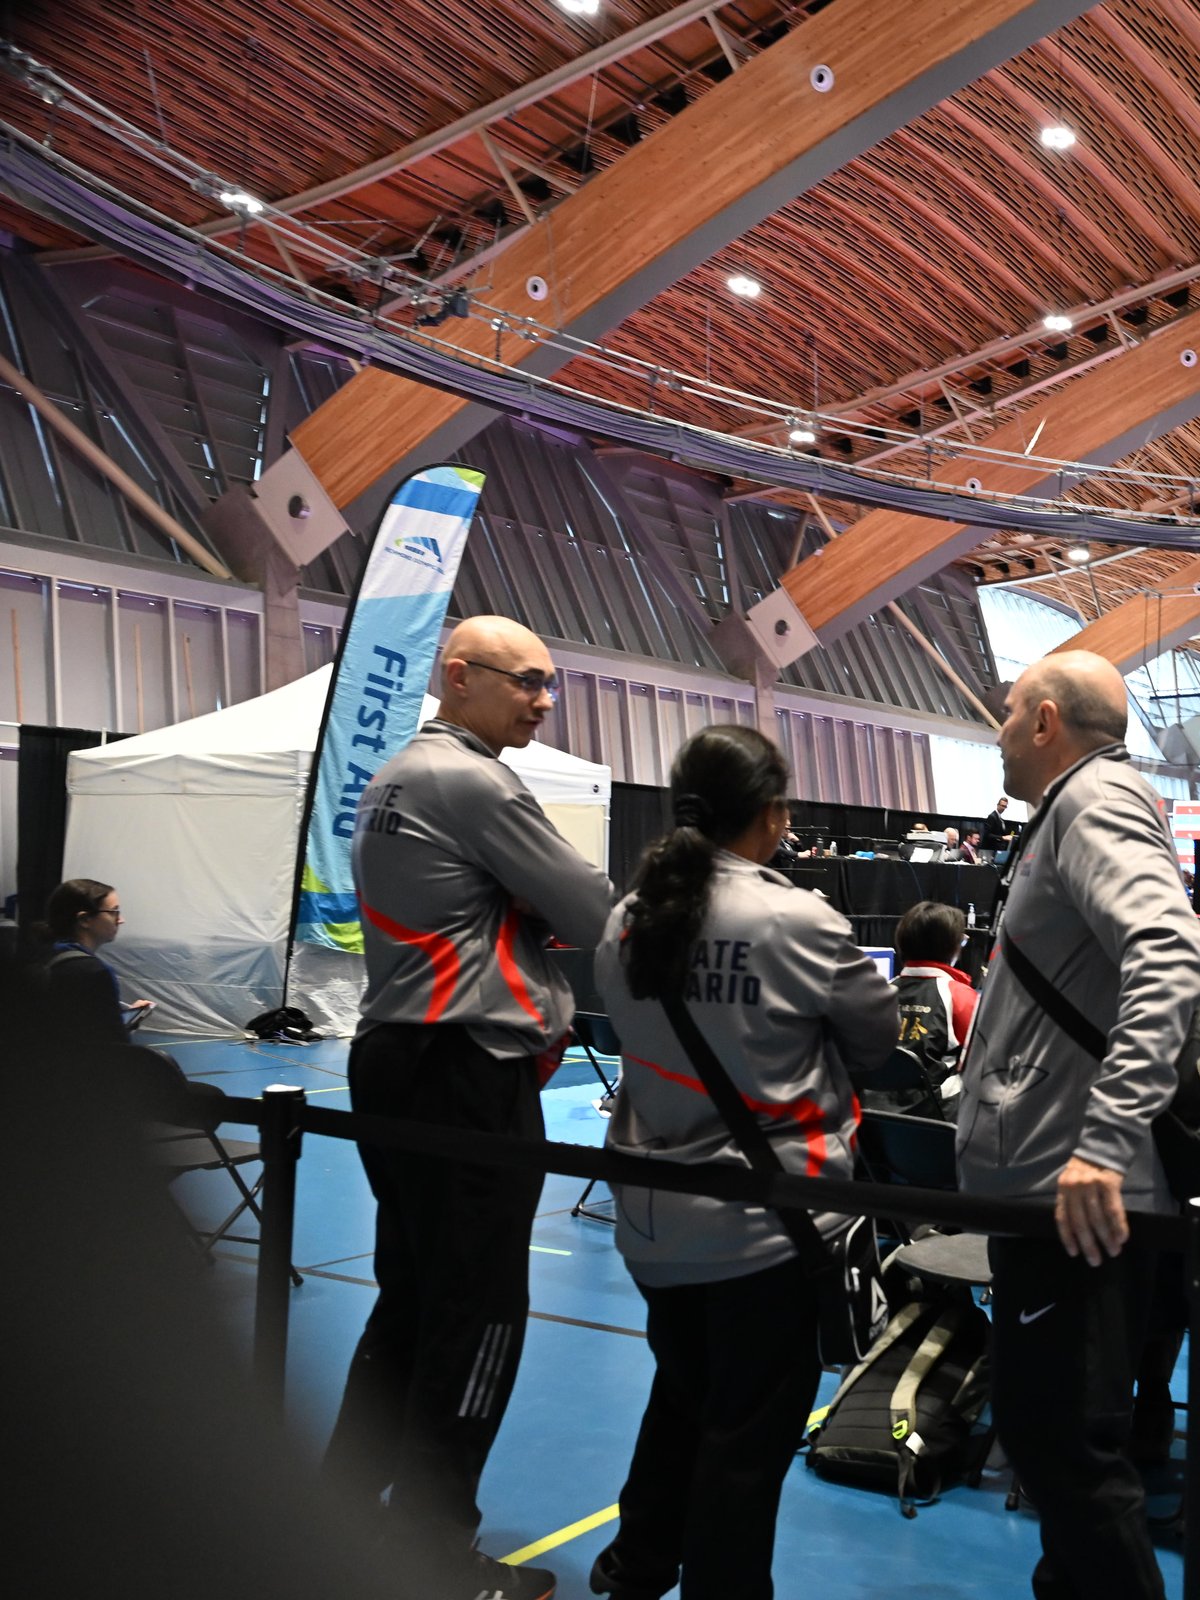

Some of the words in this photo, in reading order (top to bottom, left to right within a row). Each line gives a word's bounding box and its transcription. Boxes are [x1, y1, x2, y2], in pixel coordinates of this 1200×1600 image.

[352, 644, 407, 754] First
[691, 939, 752, 971] ATE
[687, 972, 761, 1006] ARIO
